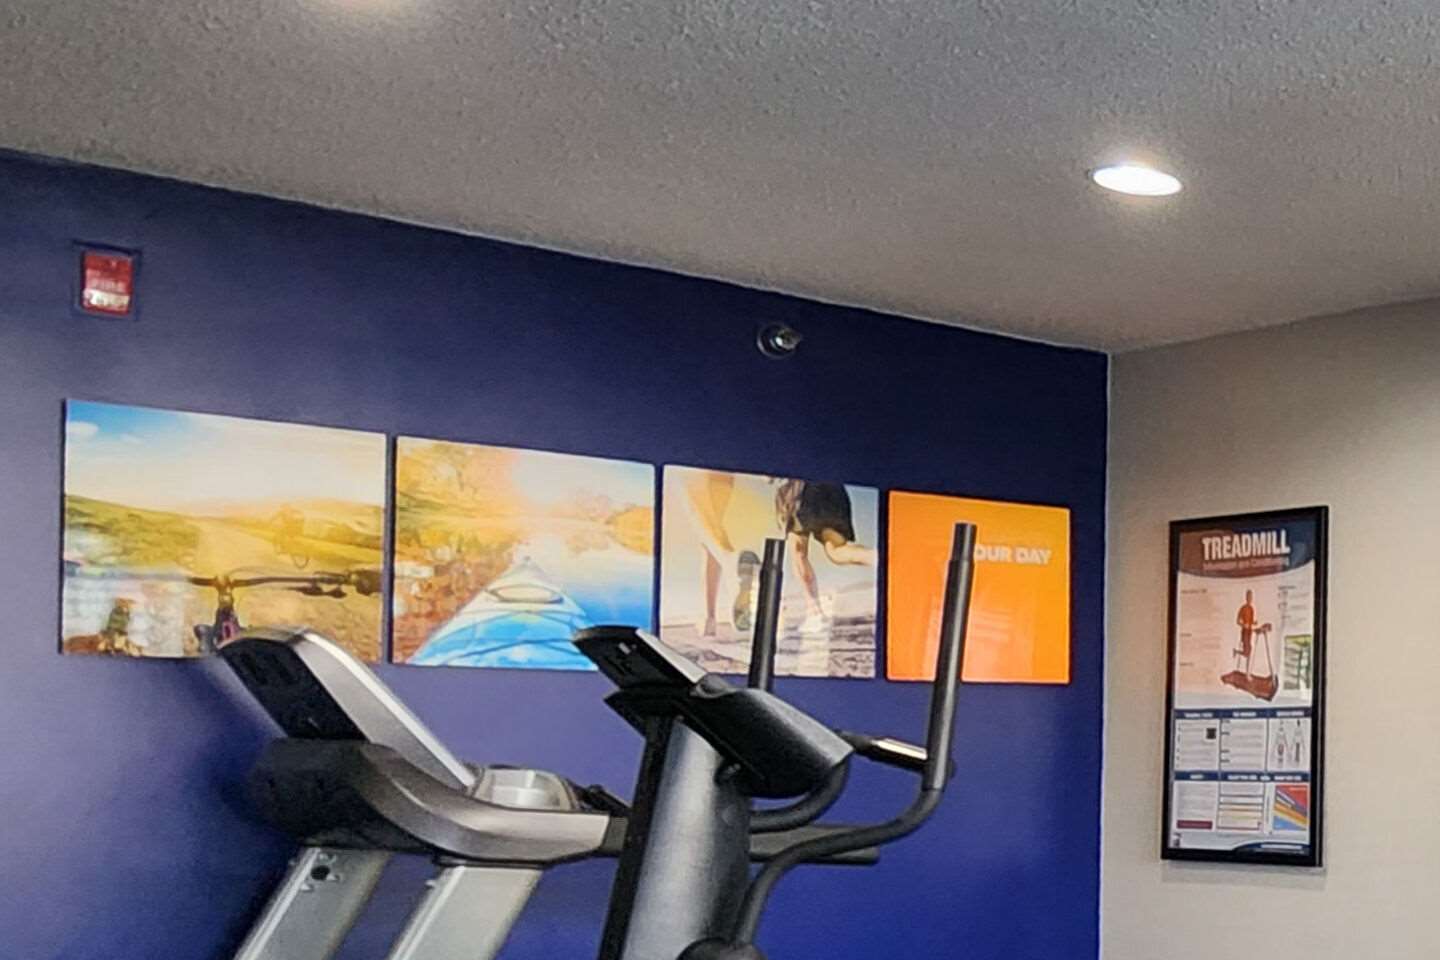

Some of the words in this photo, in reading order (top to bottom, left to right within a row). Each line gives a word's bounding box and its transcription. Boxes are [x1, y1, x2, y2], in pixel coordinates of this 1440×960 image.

[974, 544, 1010, 562] OUR
[1015, 546, 1052, 565] DAY
[1202, 529, 1291, 561] TREADMILL
